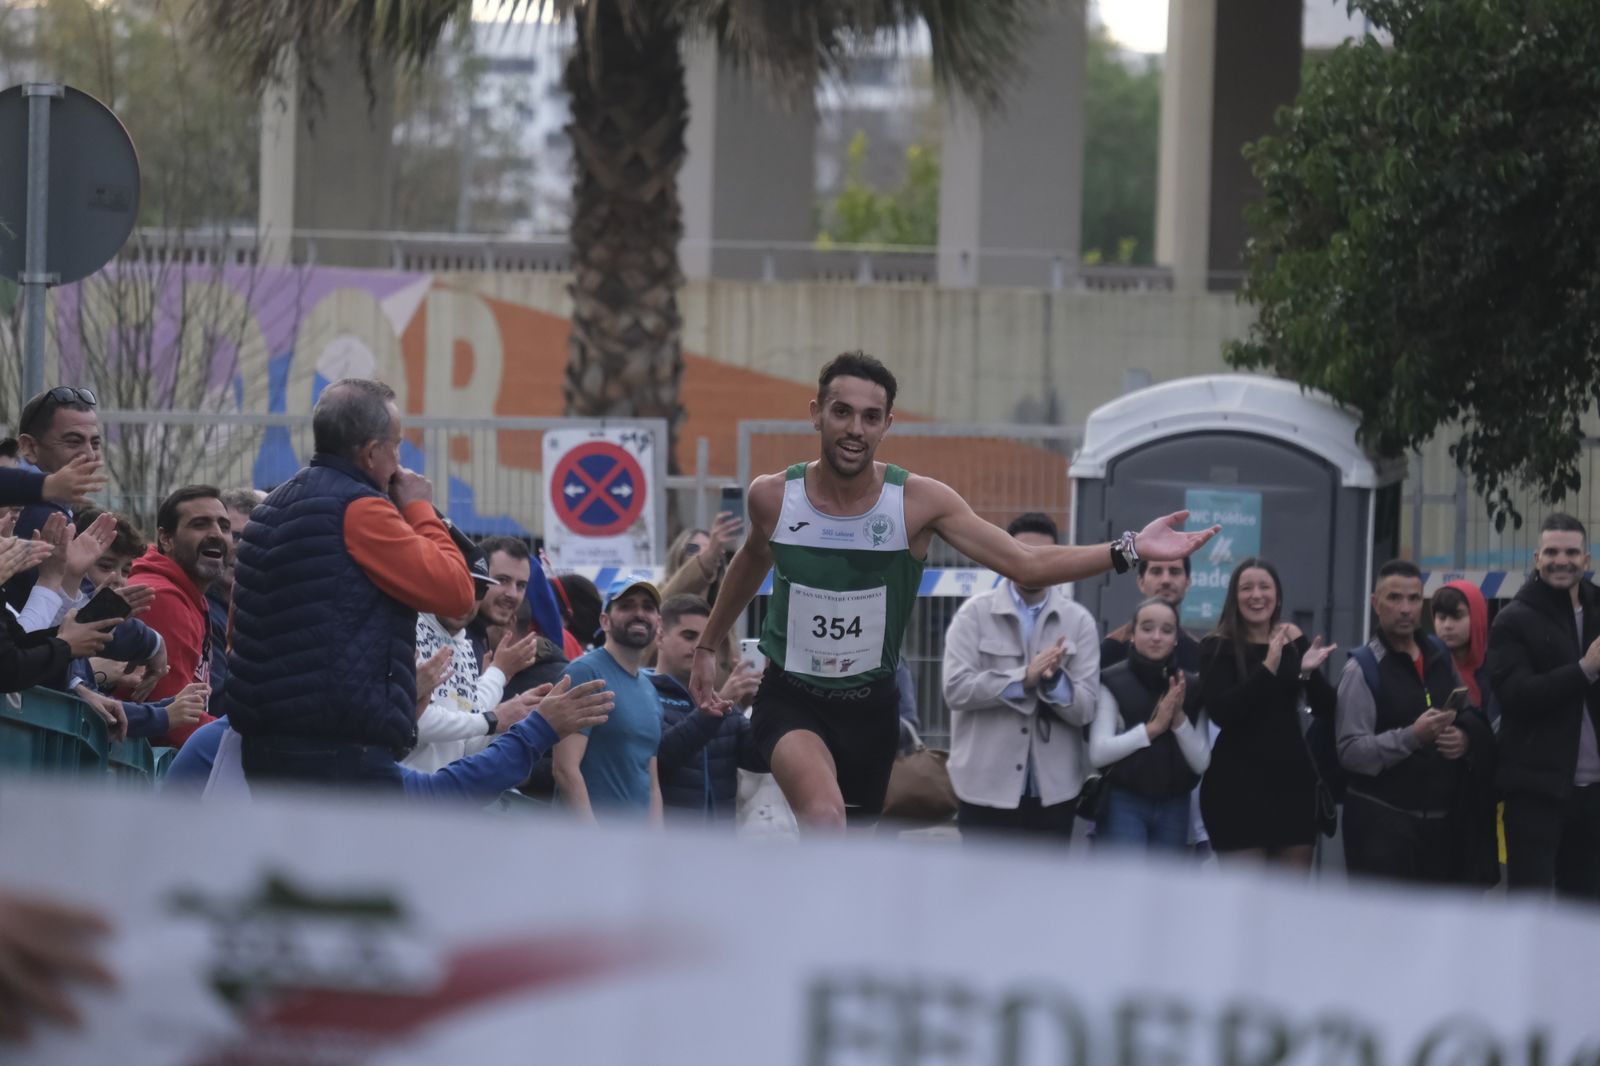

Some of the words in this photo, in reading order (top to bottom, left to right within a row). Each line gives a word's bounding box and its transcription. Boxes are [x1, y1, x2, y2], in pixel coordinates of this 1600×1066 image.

[1190, 510, 1209, 523] WC
[1213, 510, 1257, 526] Público
[1190, 568, 1231, 588] sade
[814, 593, 845, 602] SILVESTRE
[812, 615, 862, 641] 354
[827, 686, 872, 700] PRO
